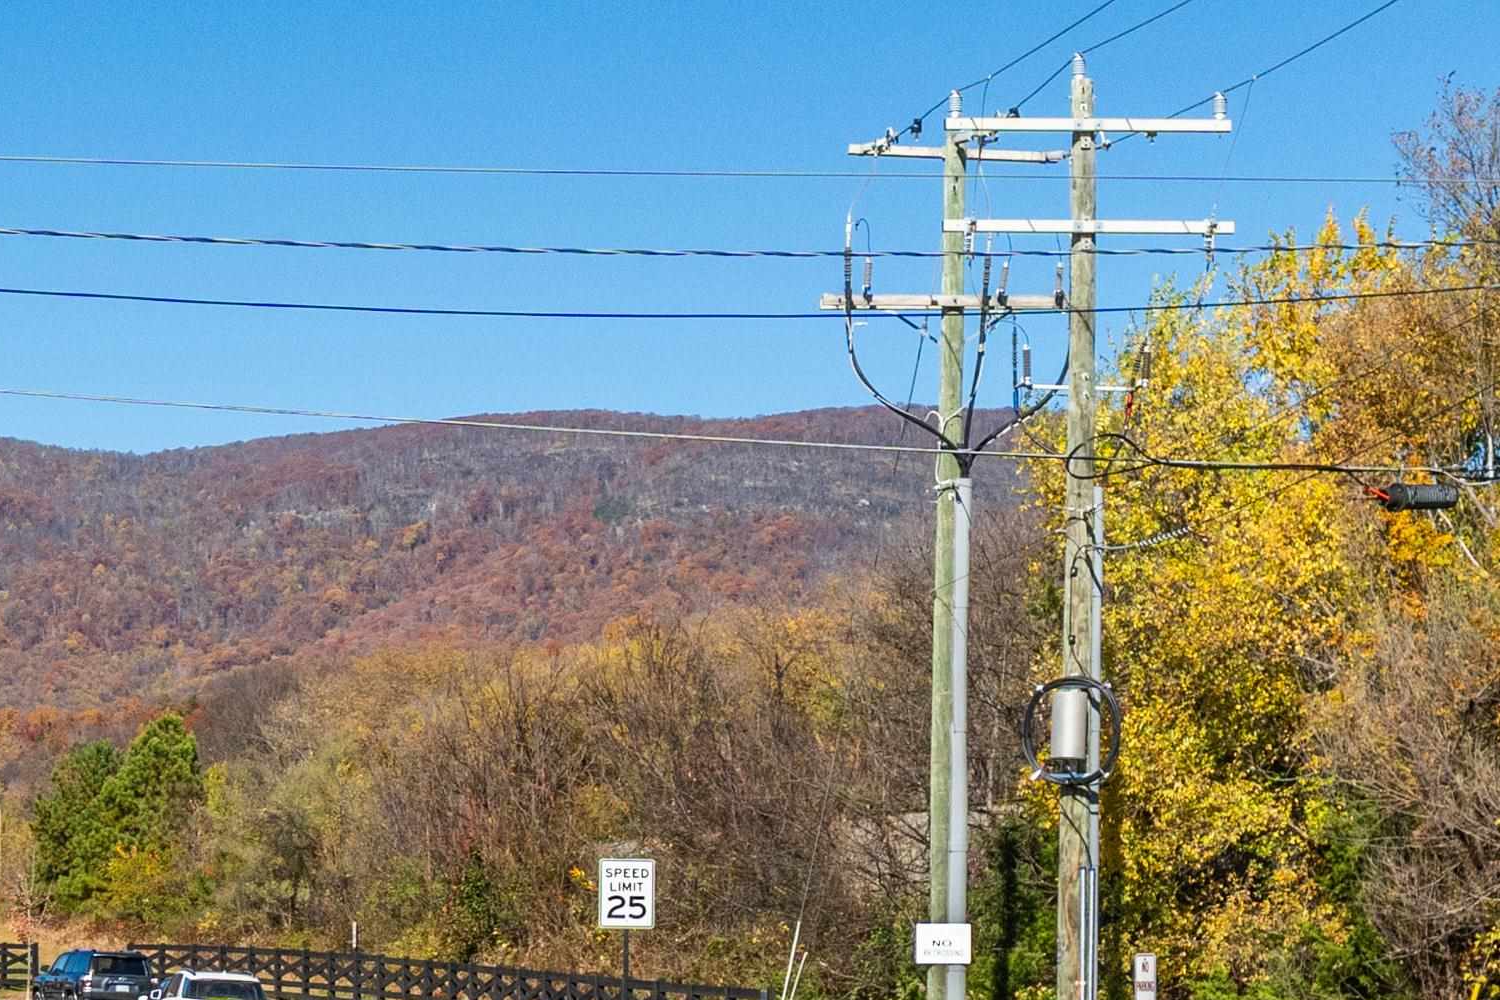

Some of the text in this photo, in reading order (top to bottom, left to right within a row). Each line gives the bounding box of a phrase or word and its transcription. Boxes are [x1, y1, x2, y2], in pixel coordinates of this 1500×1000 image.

[605, 868, 649, 879] SPEED
[610, 882, 644, 893] LIMIT
[607, 895, 647, 920] 25
[932, 940, 953, 948] NO
